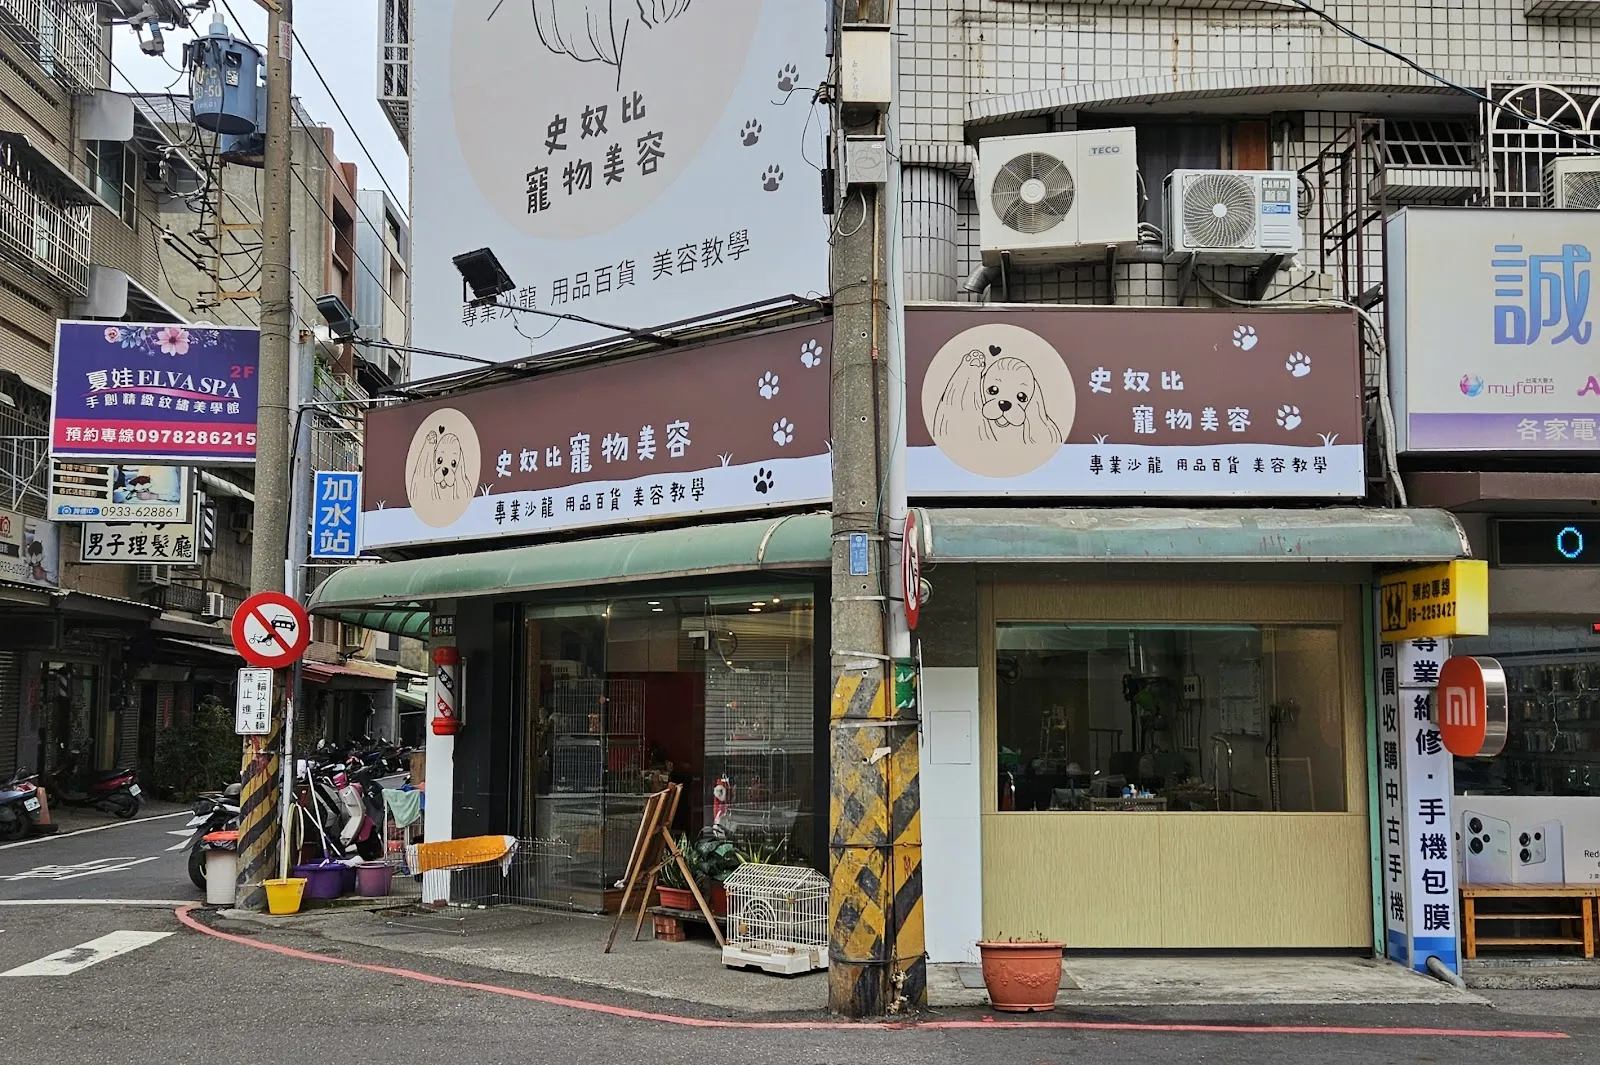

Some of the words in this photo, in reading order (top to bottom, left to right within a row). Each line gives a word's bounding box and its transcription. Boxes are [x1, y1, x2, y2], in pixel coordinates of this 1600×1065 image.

[544, 91, 646, 155] 史奴比
[1091, 146, 1120, 155] TECO
[526, 131, 666, 214] 寵物美容
[1263, 180, 1289, 189] SAMPO
[550, 259, 635, 306] 用品百貨
[652, 229, 750, 280] 美容教學
[1492, 244, 1591, 345] 誠
[86, 367, 134, 392] 夏娃
[137, 369, 196, 391] ELVA
[198, 377, 241, 399] SPA
[230, 365, 255, 379] 2F
[1088, 367, 1184, 393] 史奴比
[1488, 382, 1554, 397] myfone
[86, 393, 240, 414] 手創精緻紋繡美學館
[1132, 405, 1252, 434] 寵物美容
[1516, 418, 1600, 441] 各家電
[1089, 455, 1164, 475] 專業沙龍
[1176, 455, 1241, 474] 用品百貨
[1253, 455, 1328, 474] 美容教學
[101, 506, 179, 517] 0933-628861
[494, 497, 555, 525] 專業沙龍
[565, 488, 621, 513] 用品百貨
[633, 477, 706, 506] 美容教學
[320, 476, 353, 553] 加水站
[86, 533, 192, 558] 男子理髮廳
[1412, 578, 1450, 601] 預約專線
[1408, 602, 1456, 623] 05-2253427
[241, 673, 254, 731] 禁止進入
